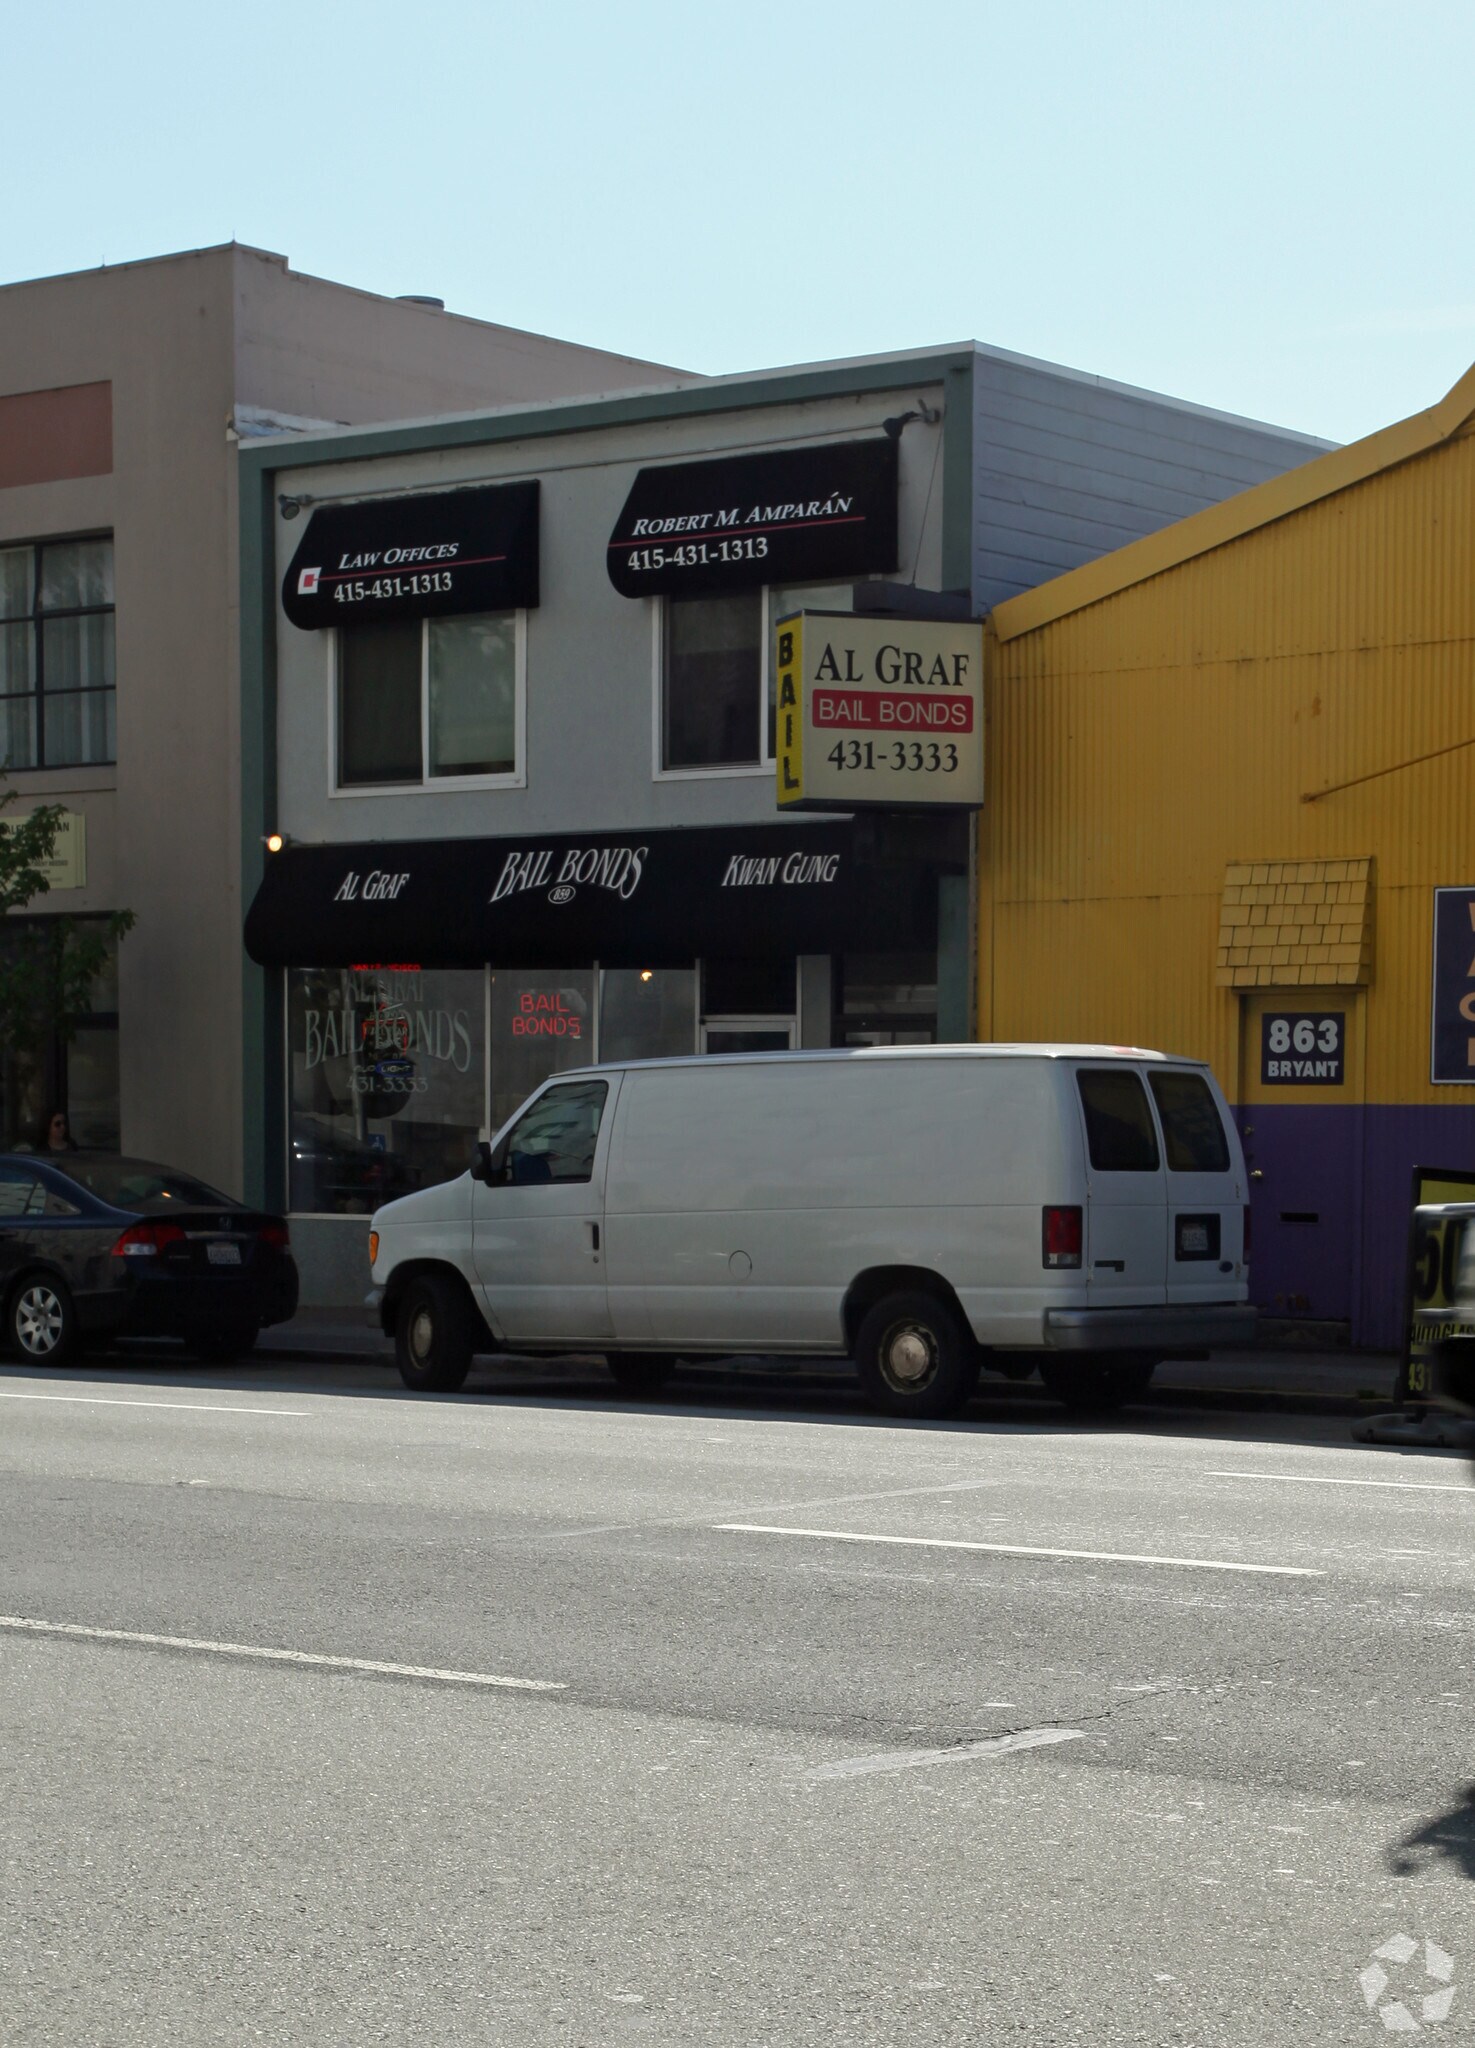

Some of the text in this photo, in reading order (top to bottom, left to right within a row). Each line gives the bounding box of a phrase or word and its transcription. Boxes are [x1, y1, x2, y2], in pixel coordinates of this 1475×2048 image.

[631, 491, 853, 536] ROBERT M. AMPARÁN
[338, 543, 459, 570] LAW OFFICES
[628, 537, 768, 571] 415-431-1313
[334, 571, 452, 603] 415-431-1313
[814, 643, 970, 687] AL GRAF
[779, 632, 799, 790] BAIL
[819, 698, 967, 726] BAIL BONDS
[828, 740, 959, 773] 431-3333
[334, 870, 410, 901] AL GRAF
[489, 847, 649, 904] BAIL BONDS
[721, 852, 840, 887] KWAN GUNG
[512, 993, 581, 1036] BAIL BONDS
[304, 1009, 472, 1073] BAIL BONDS
[1268, 1019, 1339, 1053] 863
[346, 1077, 429, 1093] 431-3333
[1267, 1060, 1338, 1077] BRYANT
